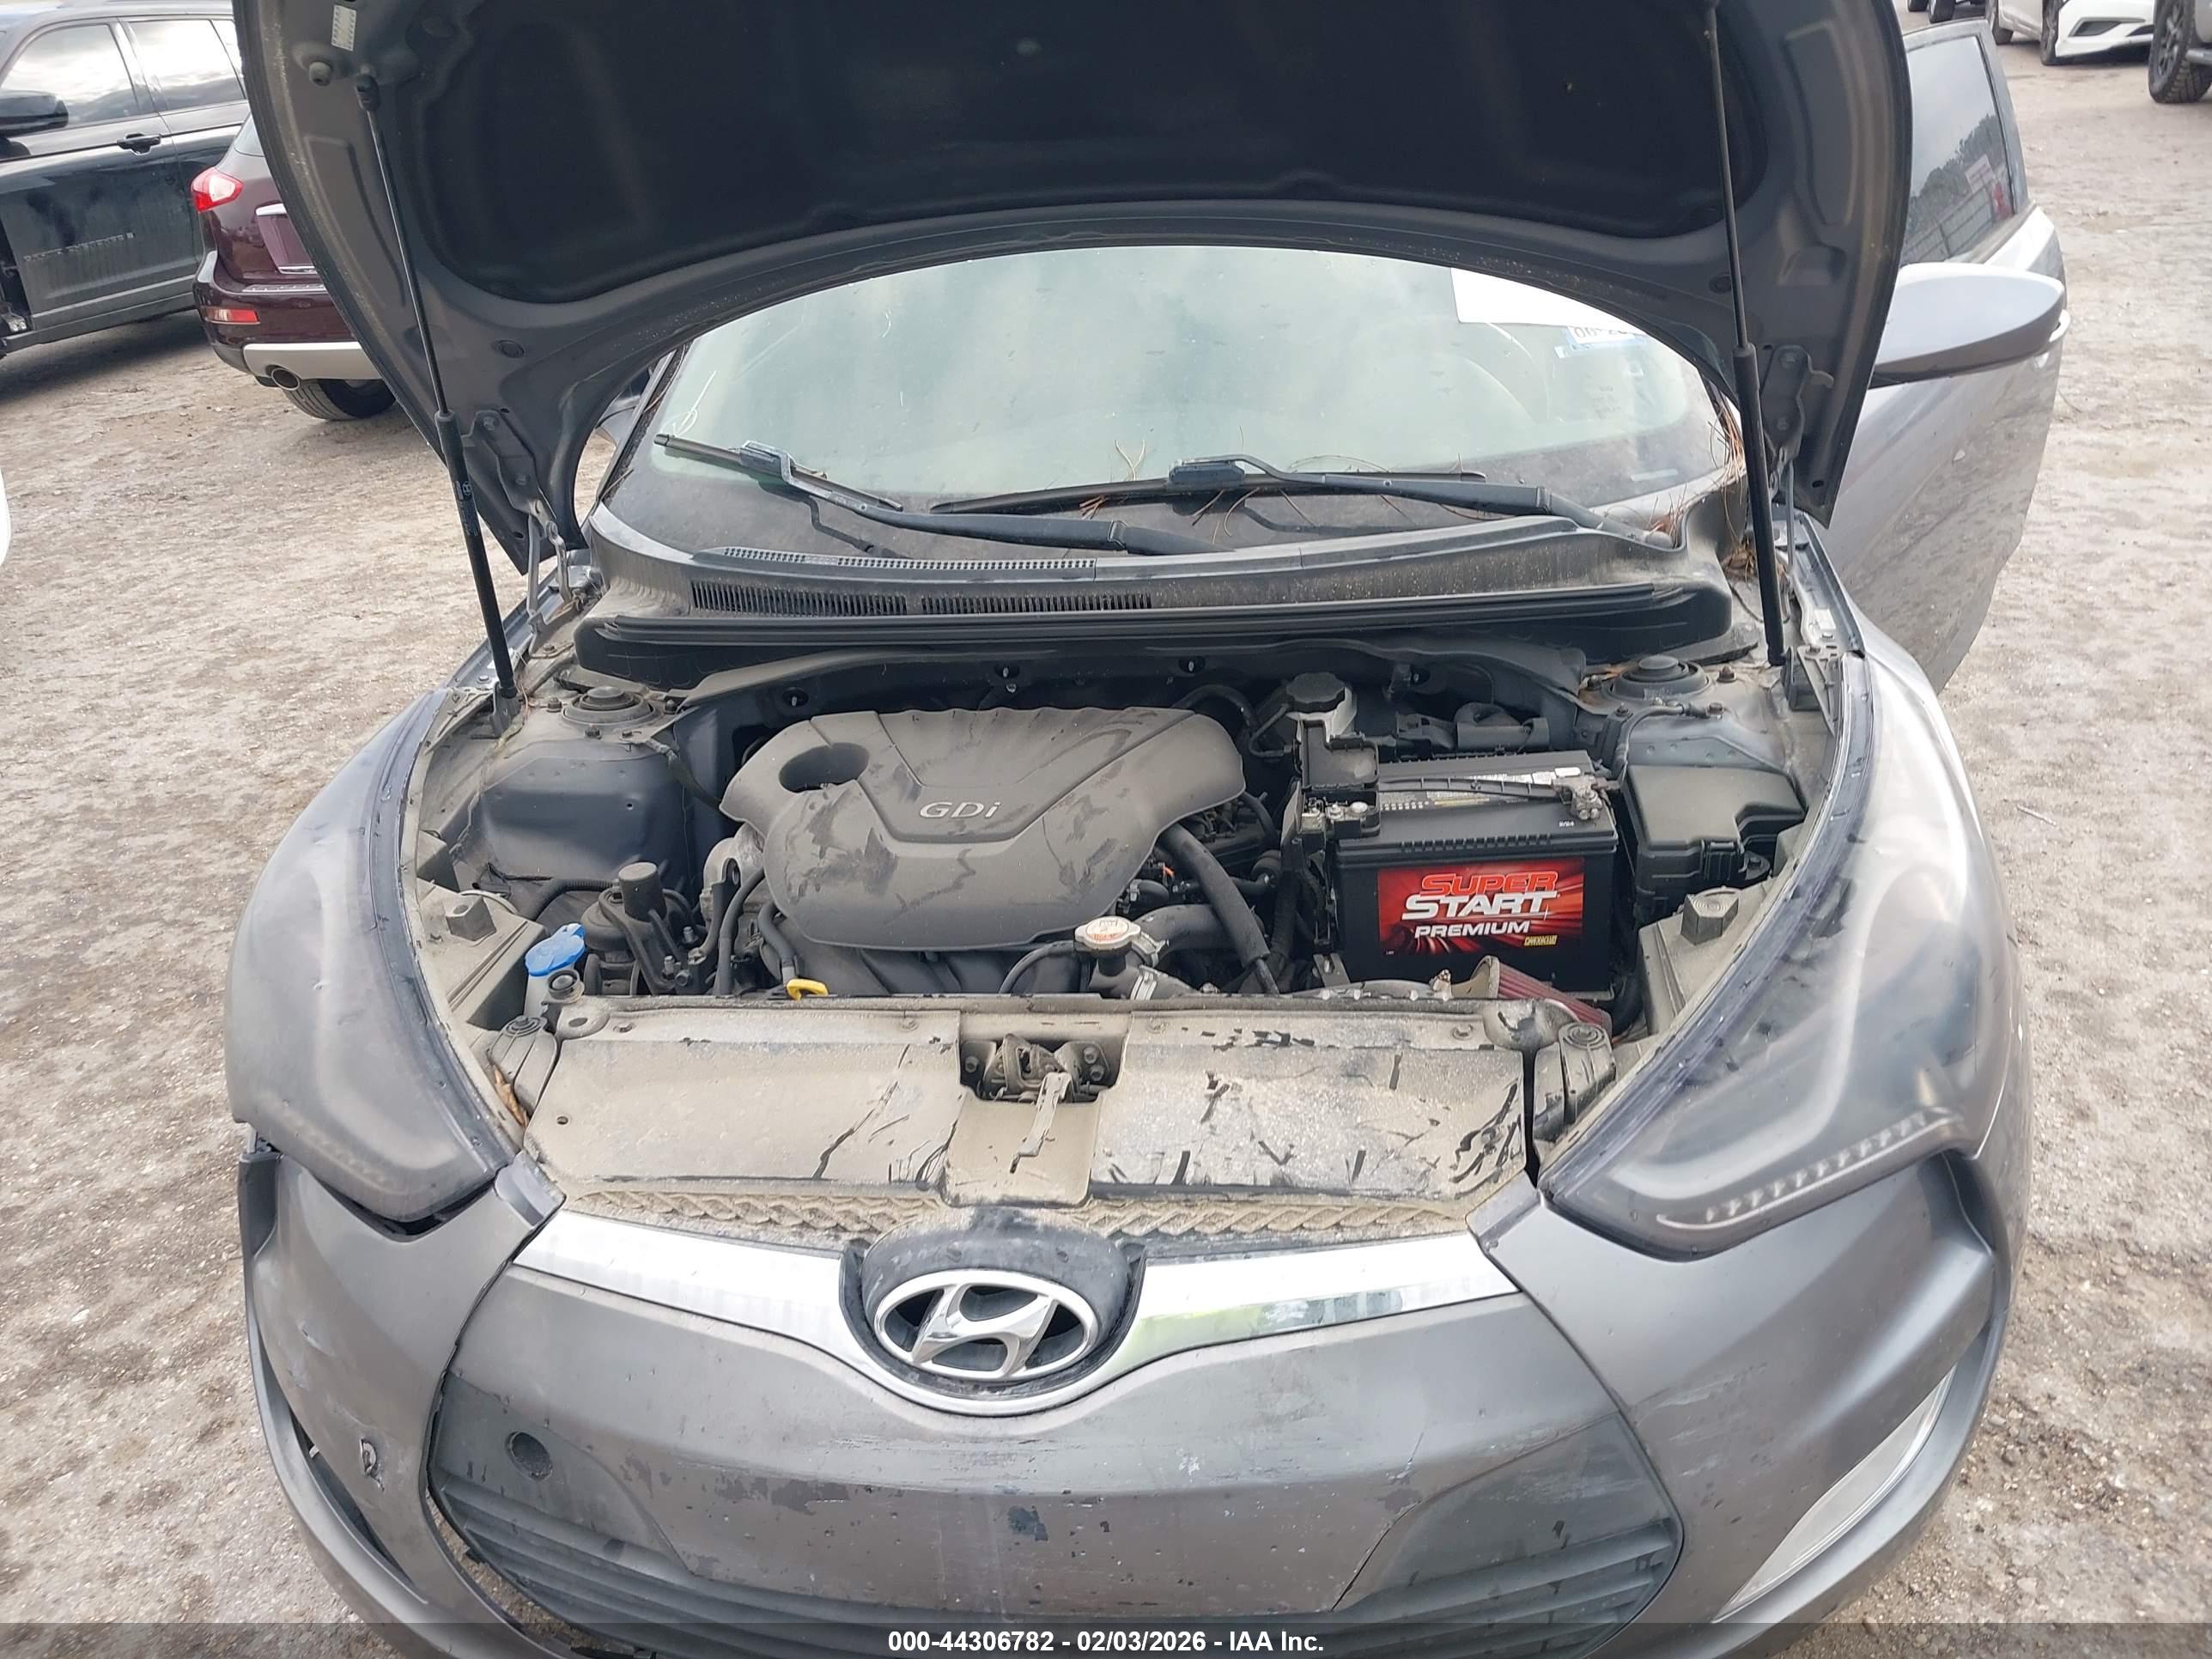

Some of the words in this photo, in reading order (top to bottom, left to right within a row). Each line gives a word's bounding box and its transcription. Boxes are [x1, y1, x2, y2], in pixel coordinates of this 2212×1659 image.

[920, 801, 1001, 818] GDi
[1419, 871, 1559, 896] SUPER
[1401, 890, 1558, 921] START
[1414, 921, 1531, 939] PREMIUM
